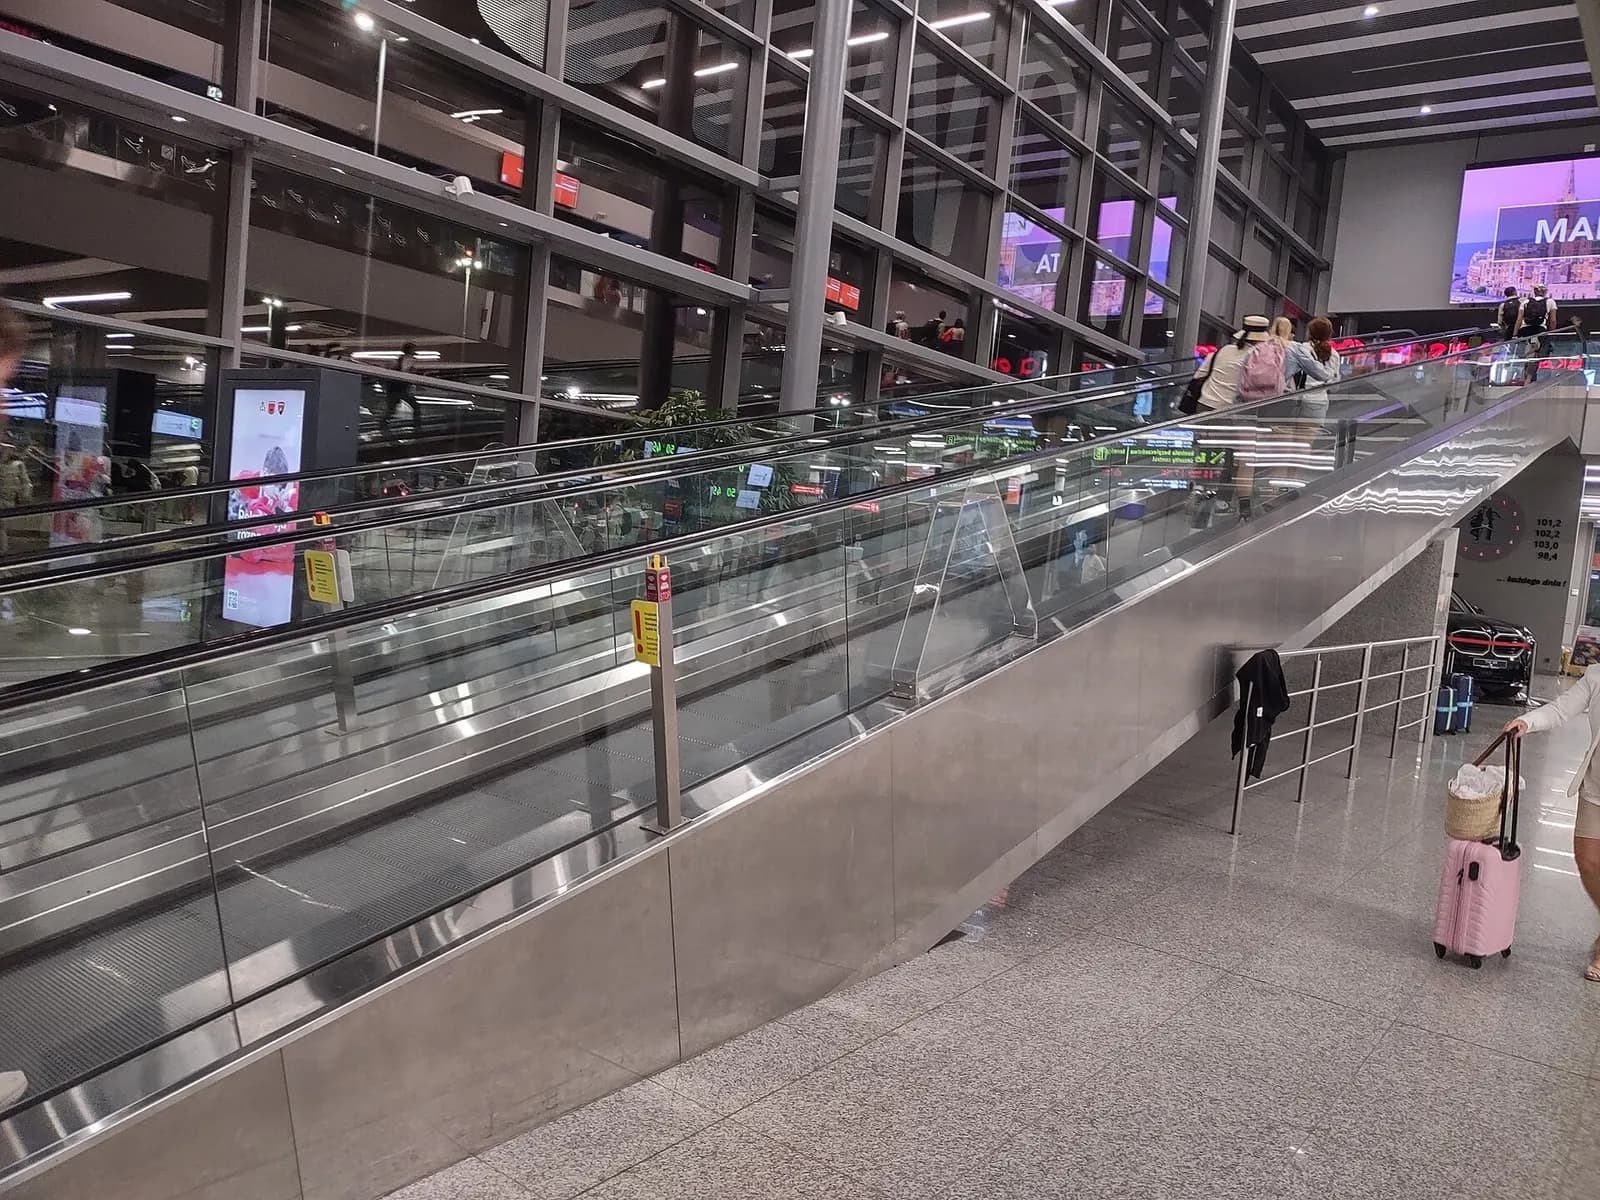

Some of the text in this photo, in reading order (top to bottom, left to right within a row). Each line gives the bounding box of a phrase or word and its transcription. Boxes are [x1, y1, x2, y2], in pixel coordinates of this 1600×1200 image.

[1535, 215, 1600, 244] MA
[1536, 518, 1562, 528] 101,2
[1535, 529, 1561, 539] 102,2
[1533, 540, 1559, 550] 103,0
[1537, 552, 1558, 561] 98,4
